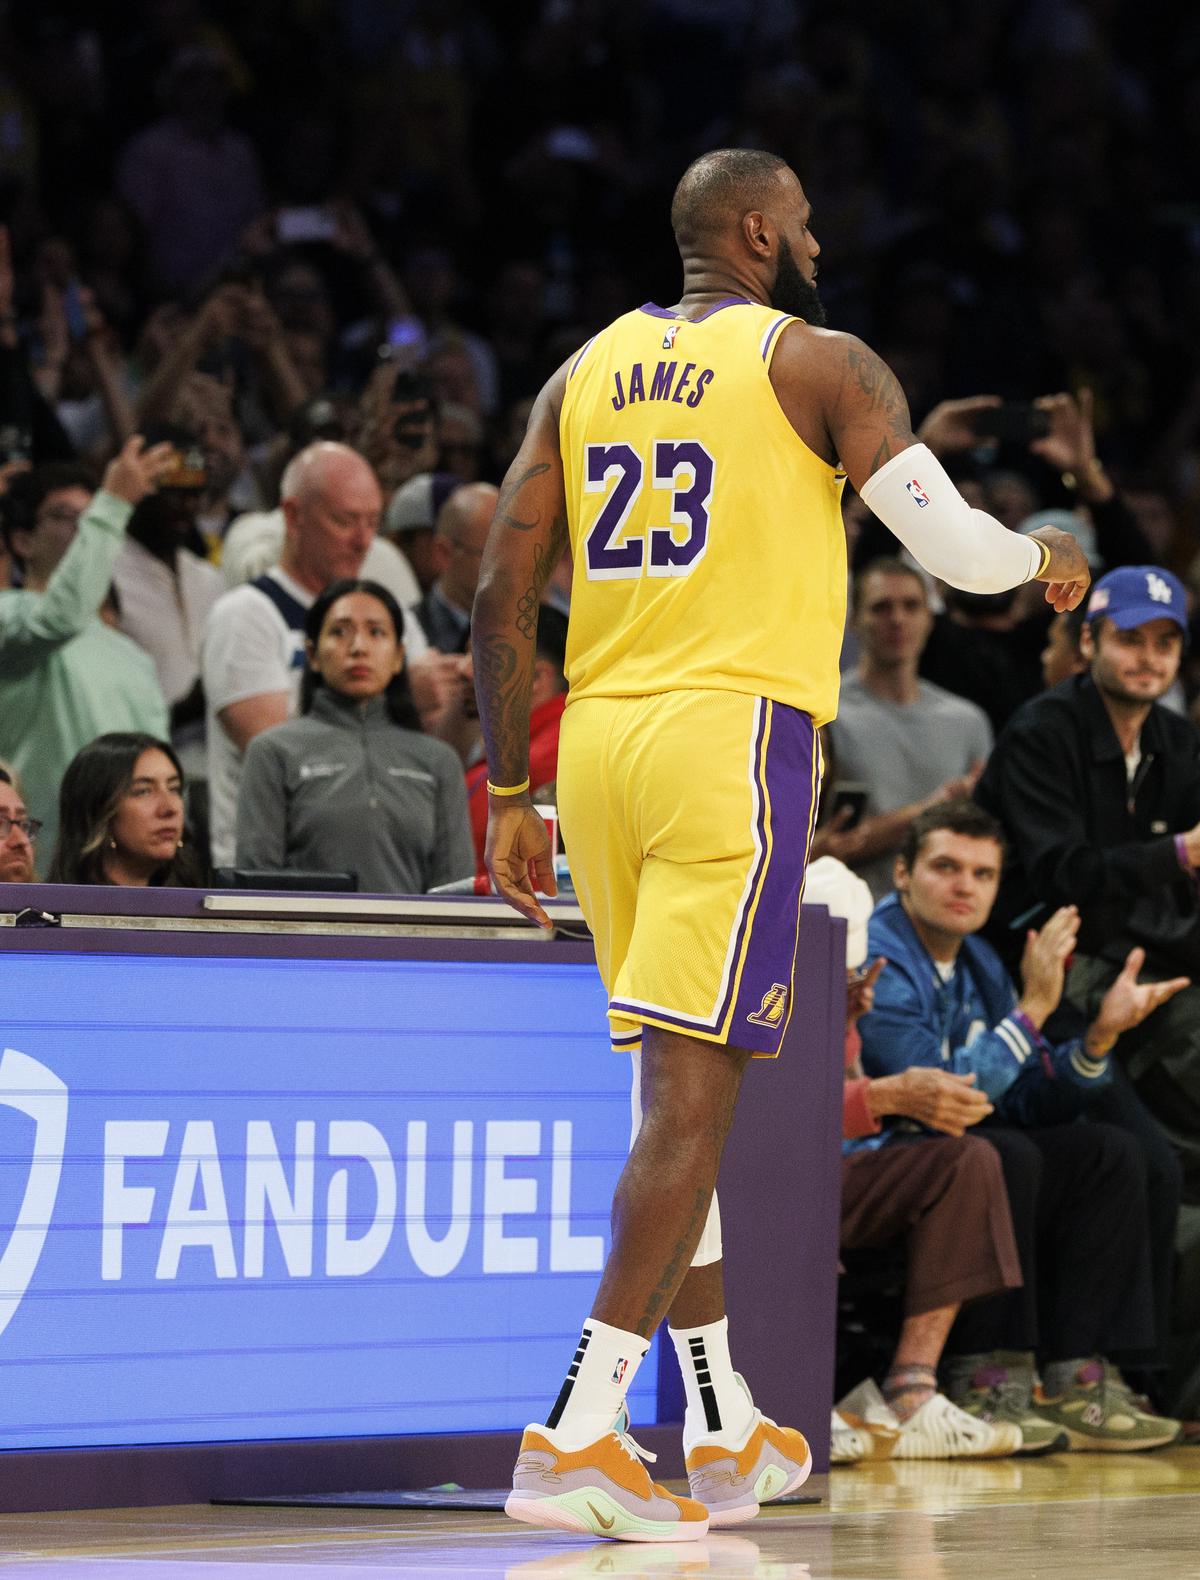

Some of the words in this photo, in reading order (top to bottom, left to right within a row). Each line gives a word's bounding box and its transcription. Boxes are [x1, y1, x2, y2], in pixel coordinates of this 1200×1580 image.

[611, 361, 715, 411] JAMES
[584, 439, 717, 581] 23
[100, 1120, 605, 1281] FANDUEL
